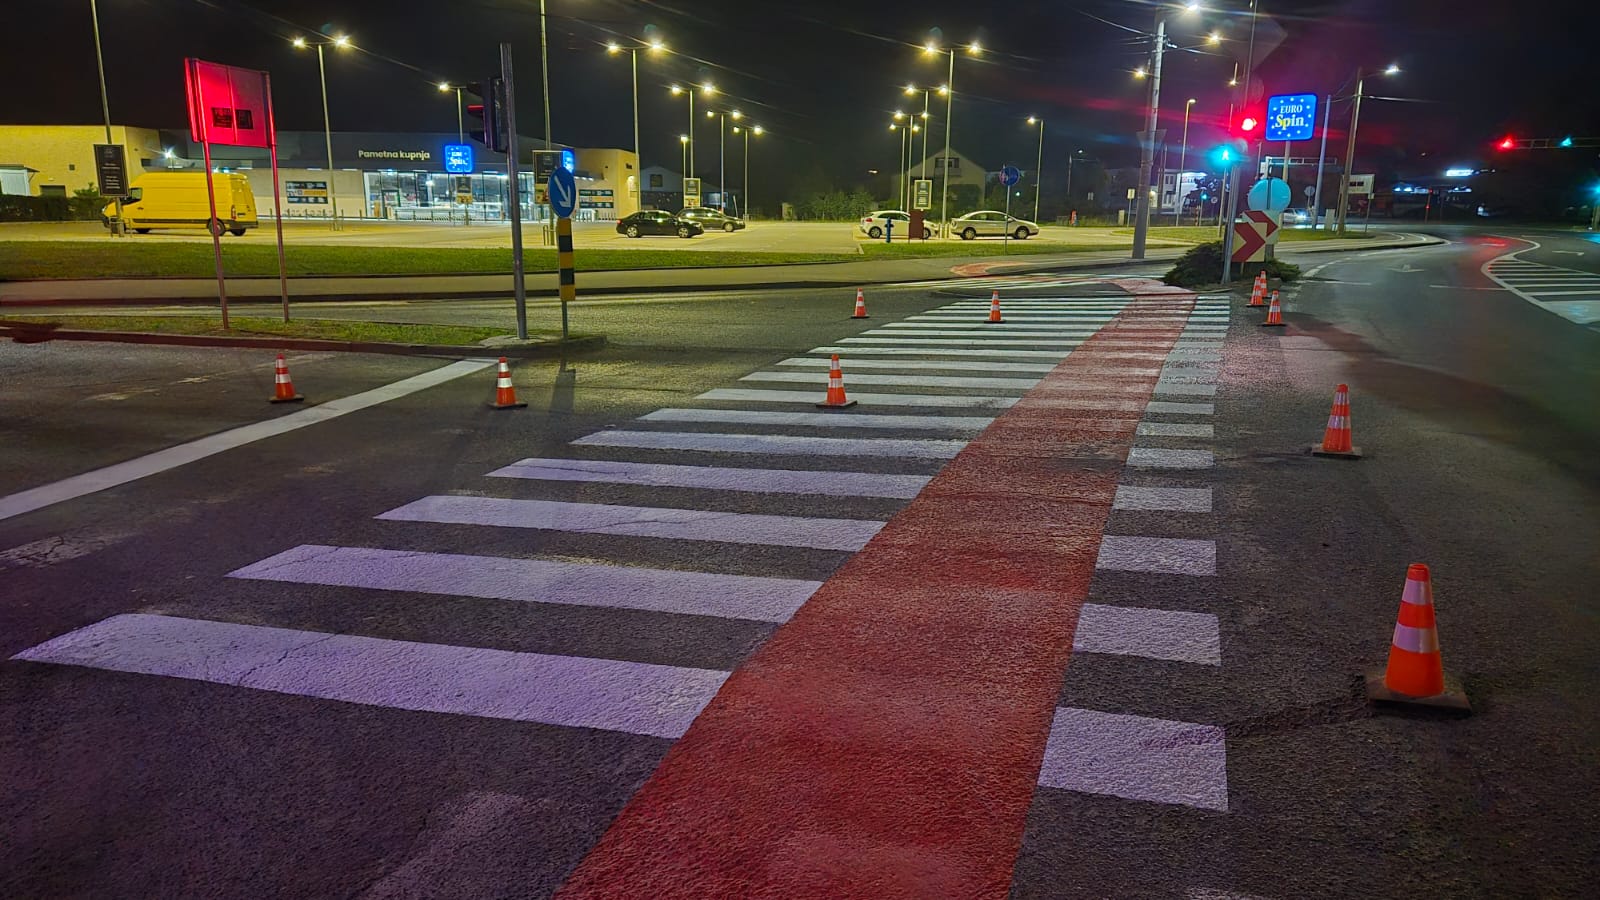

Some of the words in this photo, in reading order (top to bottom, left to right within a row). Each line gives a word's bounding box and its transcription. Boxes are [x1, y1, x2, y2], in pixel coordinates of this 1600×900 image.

[1280, 104, 1303, 113] EURO
[1274, 114, 1304, 130] Spin
[358, 150, 398, 158] Pametna
[399, 150, 430, 160] kupnja
